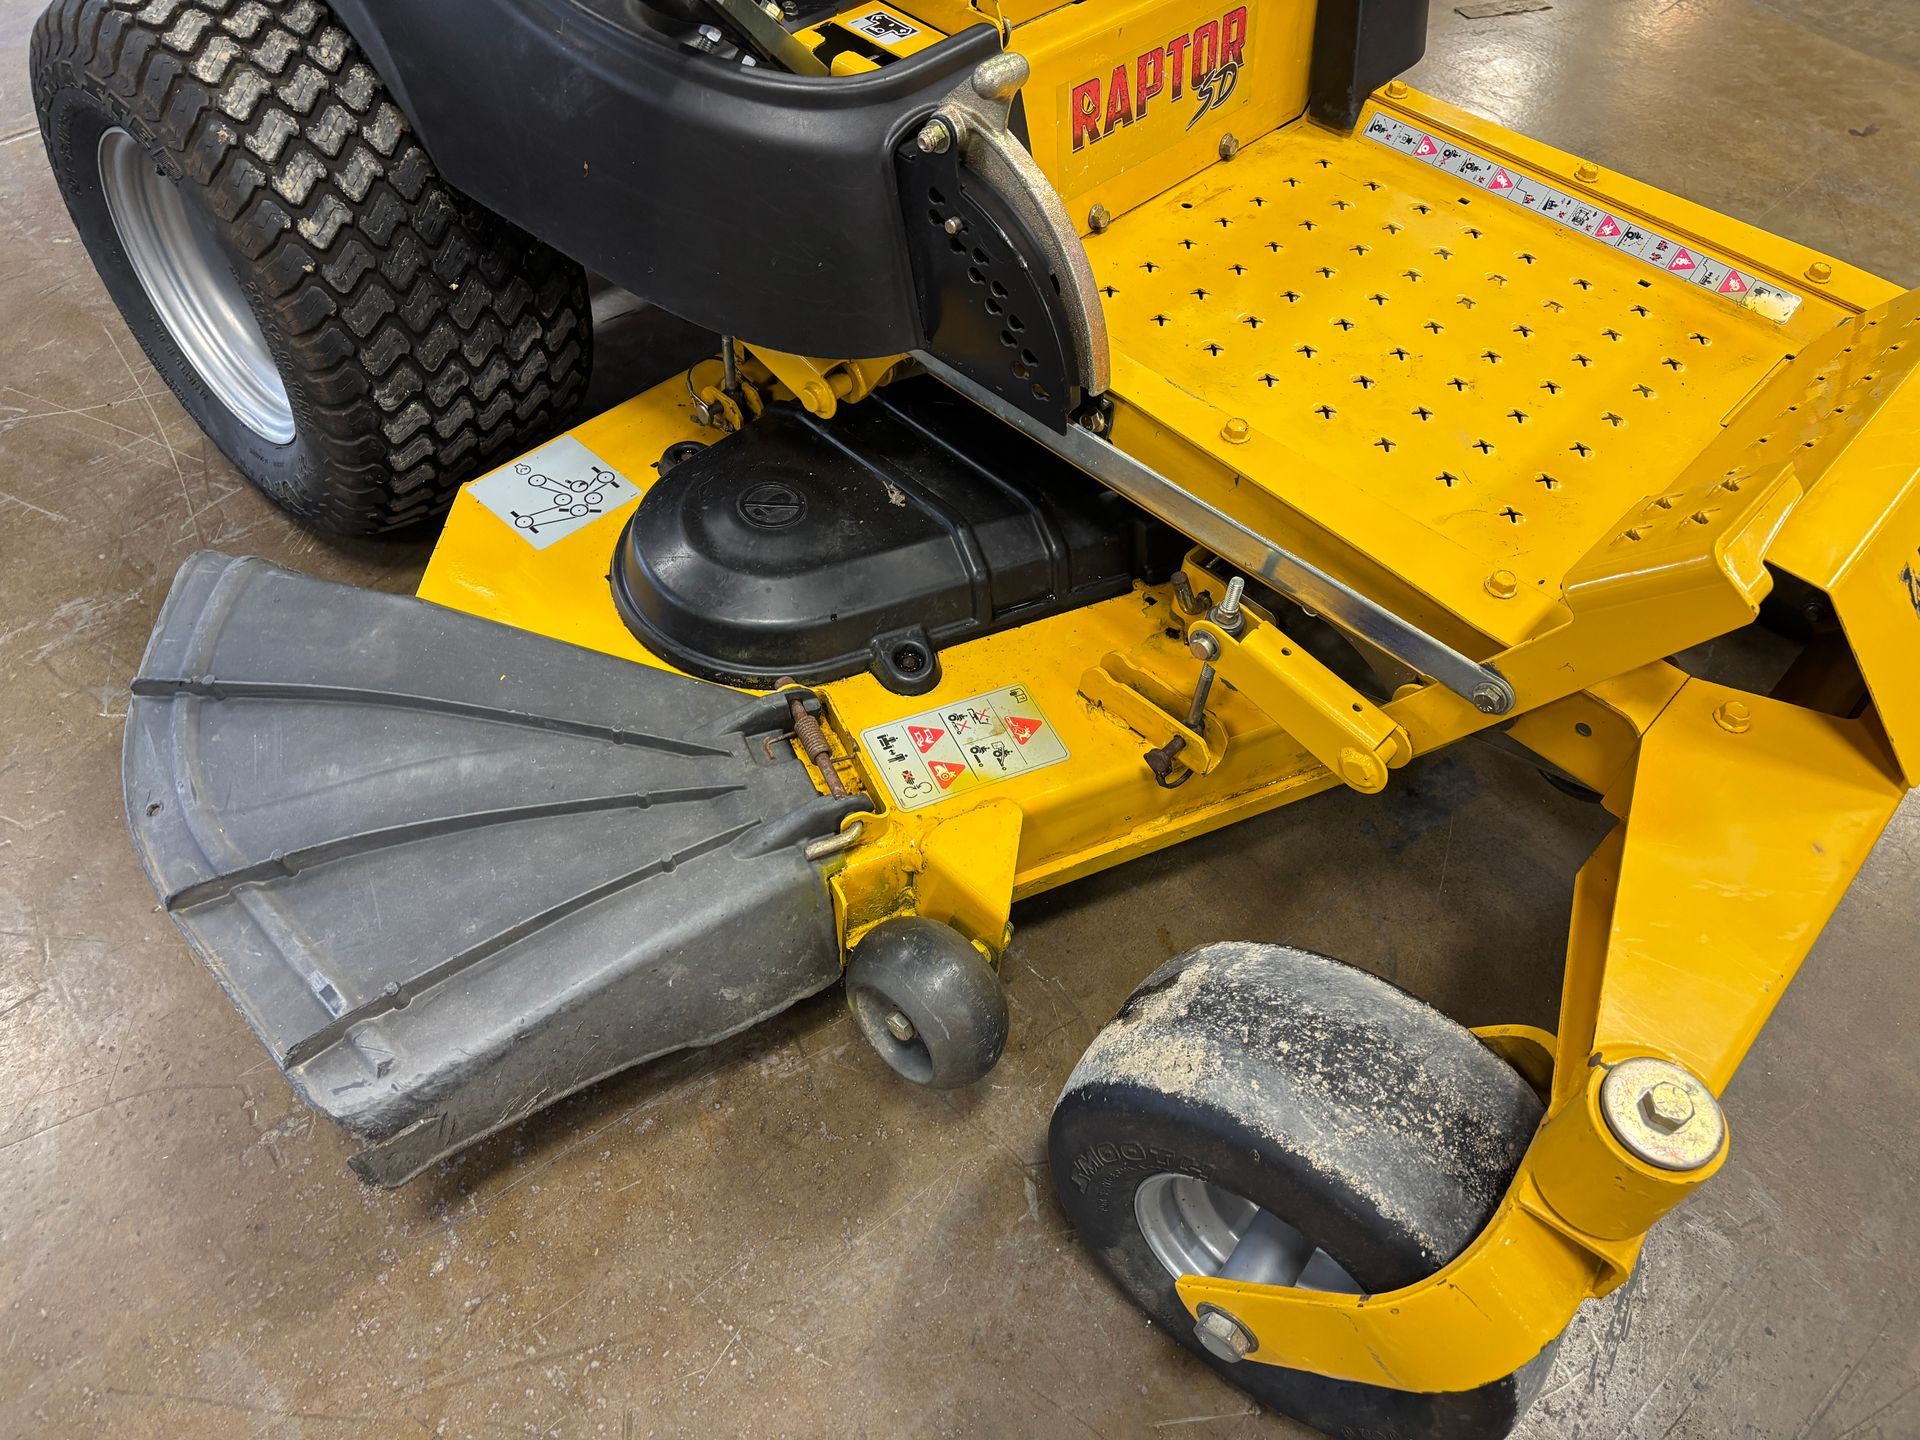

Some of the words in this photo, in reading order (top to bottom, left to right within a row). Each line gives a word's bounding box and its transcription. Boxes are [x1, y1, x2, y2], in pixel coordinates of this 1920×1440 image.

[1072, 5, 1248, 153] RAPTOR
[1186, 61, 1239, 131] SD
[1071, 1143, 1216, 1194] SMOOTH
